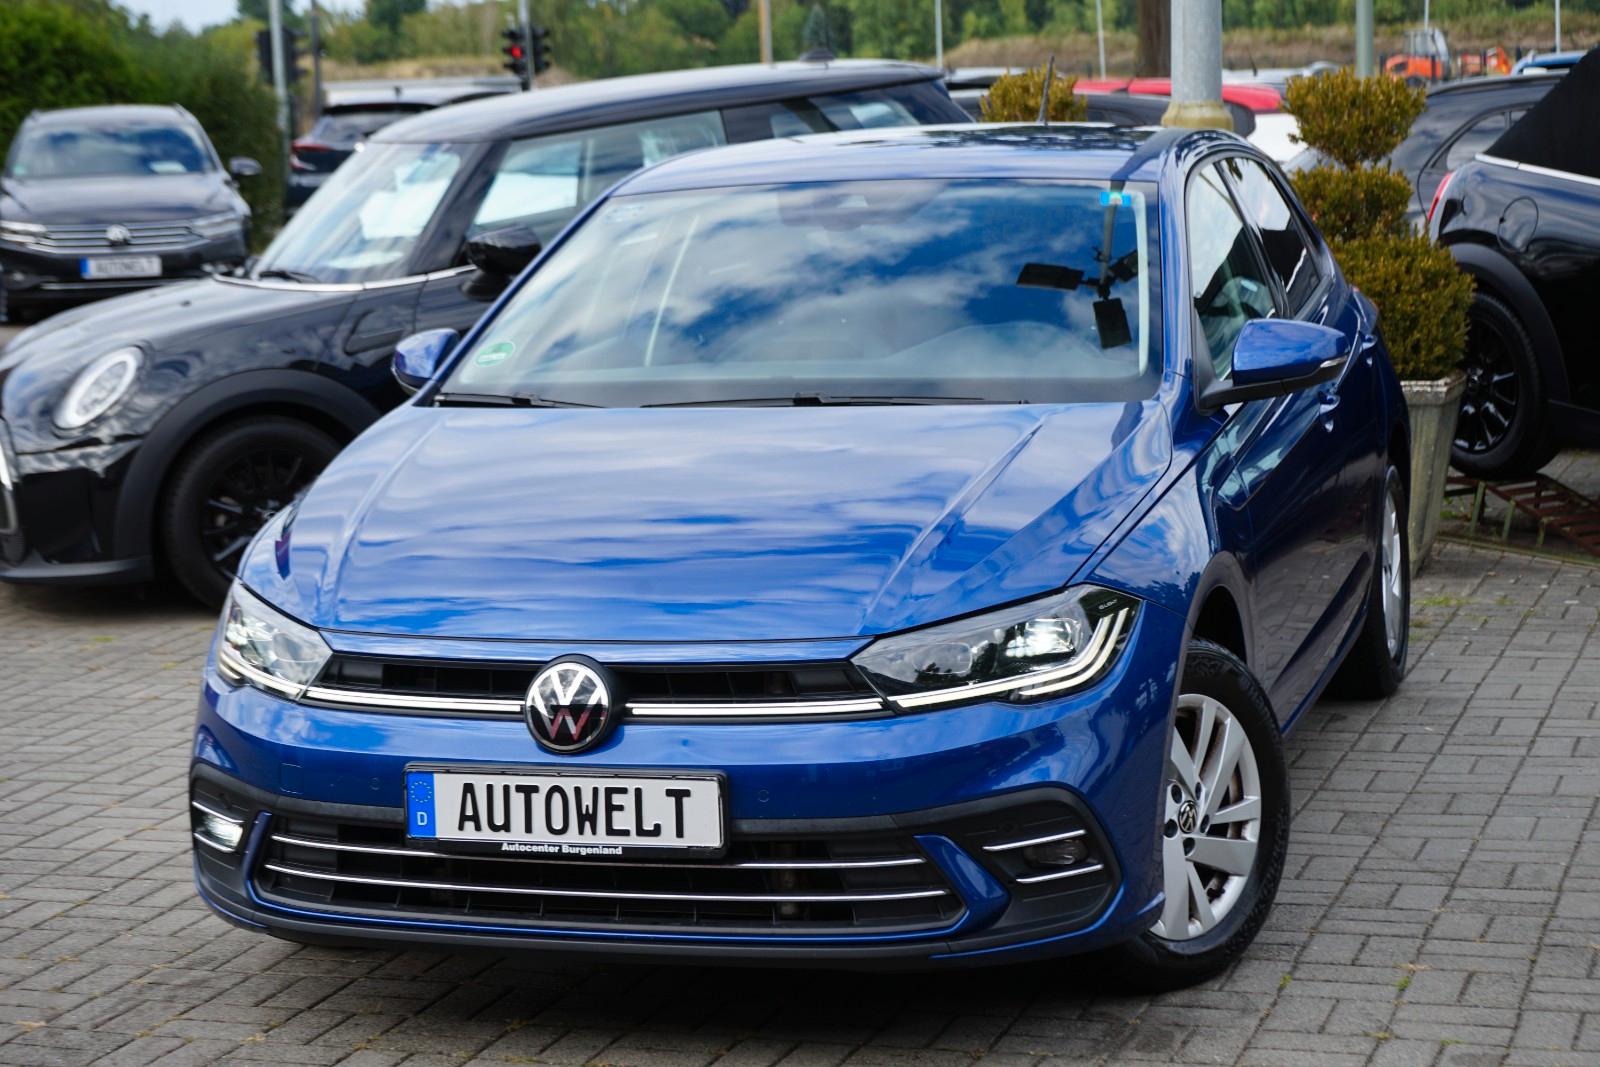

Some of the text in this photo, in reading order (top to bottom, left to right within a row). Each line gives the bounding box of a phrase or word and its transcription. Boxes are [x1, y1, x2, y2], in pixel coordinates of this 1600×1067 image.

[458, 782, 691, 838] AUTOWELT
[416, 811, 428, 826] D
[501, 842, 623, 856] Autocenter Burgenland
